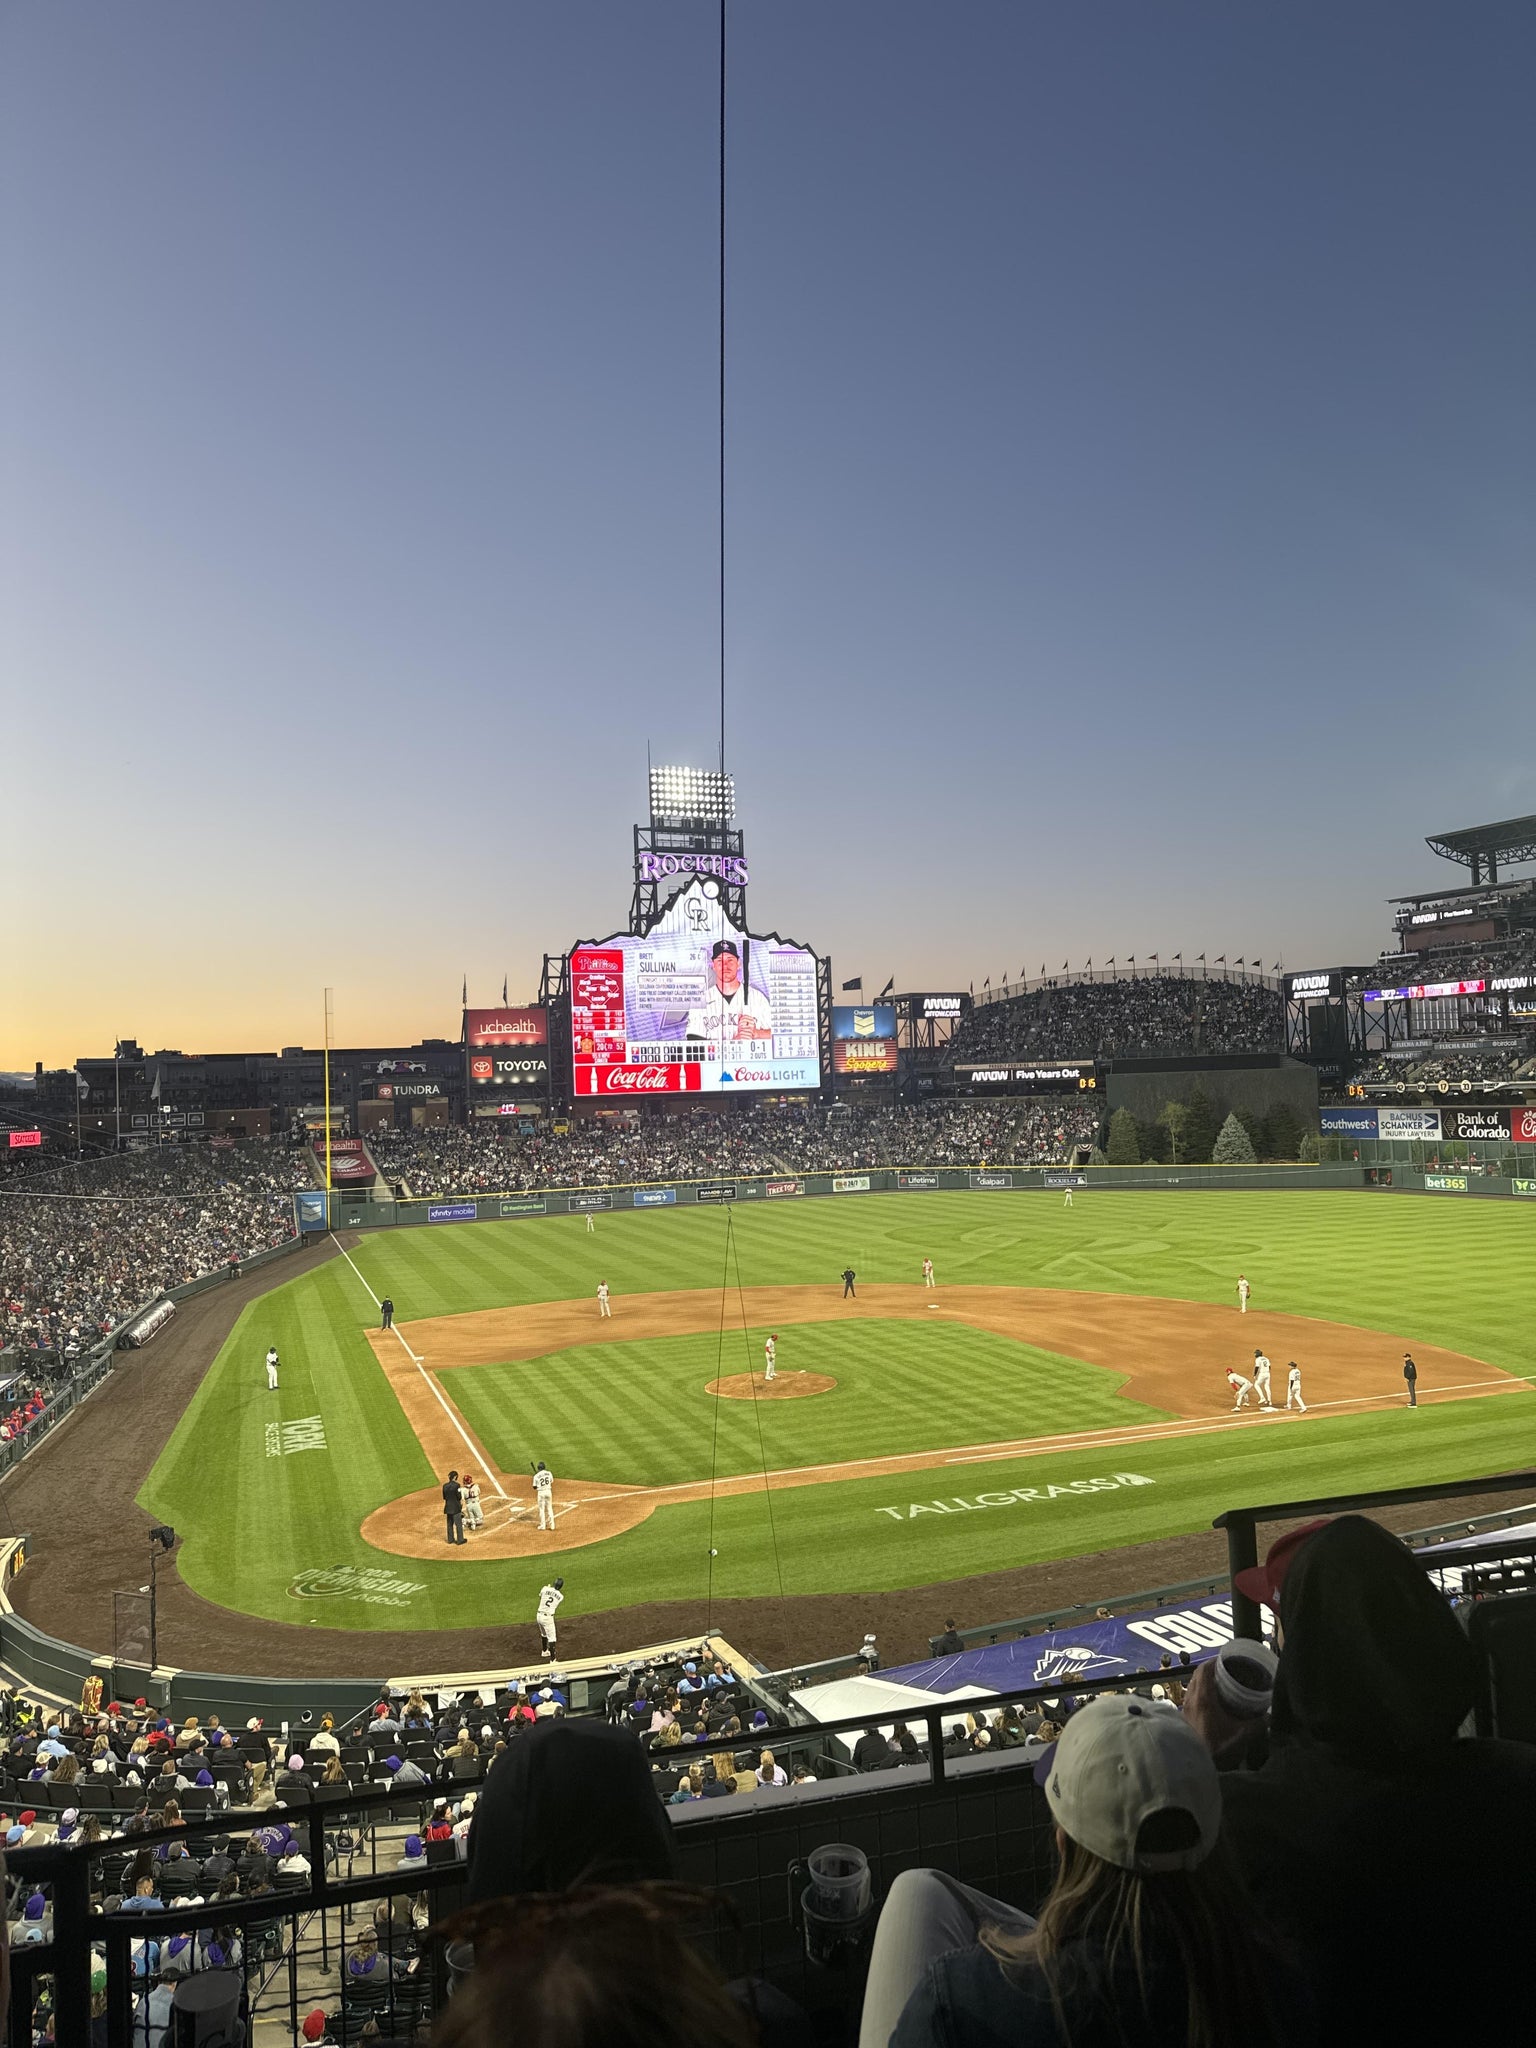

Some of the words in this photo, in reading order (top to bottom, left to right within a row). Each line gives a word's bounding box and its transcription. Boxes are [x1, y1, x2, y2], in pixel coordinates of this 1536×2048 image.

[640, 852, 749, 885] ROCKIES
[639, 962, 676, 973] SULLIVAN
[1292, 975, 1330, 990] ARROW
[1294, 989, 1330, 999] arrow.com
[924, 999, 960, 1010] ARROW
[480, 1019, 536, 1033] uchealth
[846, 1043, 886, 1058] KING
[496, 1060, 547, 1071] TOYOTA
[846, 1057, 888, 1072] Soopers
[606, 1066, 670, 1089] Coca-Cola
[734, 1067, 770, 1082] Coors
[773, 1070, 805, 1080] LIGHT
[972, 1071, 1008, 1080] ARROW
[1036, 1070, 1060, 1078] Years
[1062, 1069, 1080, 1077] Out
[394, 1085, 440, 1095] TUNDRA
[1321, 1119, 1369, 1130] Southwest
[1457, 1113, 1485, 1125] Bank
[1486, 1112, 1498, 1124] of
[1381, 1122, 1423, 1130] SCHANKER
[1457, 1126, 1510, 1138] Colorado
[319, 1140, 356, 1150] uhealth
[979, 1177, 1004, 1186] dialpad
[1427, 1177, 1466, 1189] bet365
[281, 1415, 328, 1455] YORK
[540, 1477, 549, 1486] 26
[874, 1478, 1120, 1520] TALLGRASS
[292, 1569, 386, 1589] OPENING
[374, 1580, 429, 1594] DAY
[349, 1594, 412, 1606] Adobe
[545, 1596, 554, 1607] 2
[1126, 1600, 1236, 1654] COLO
